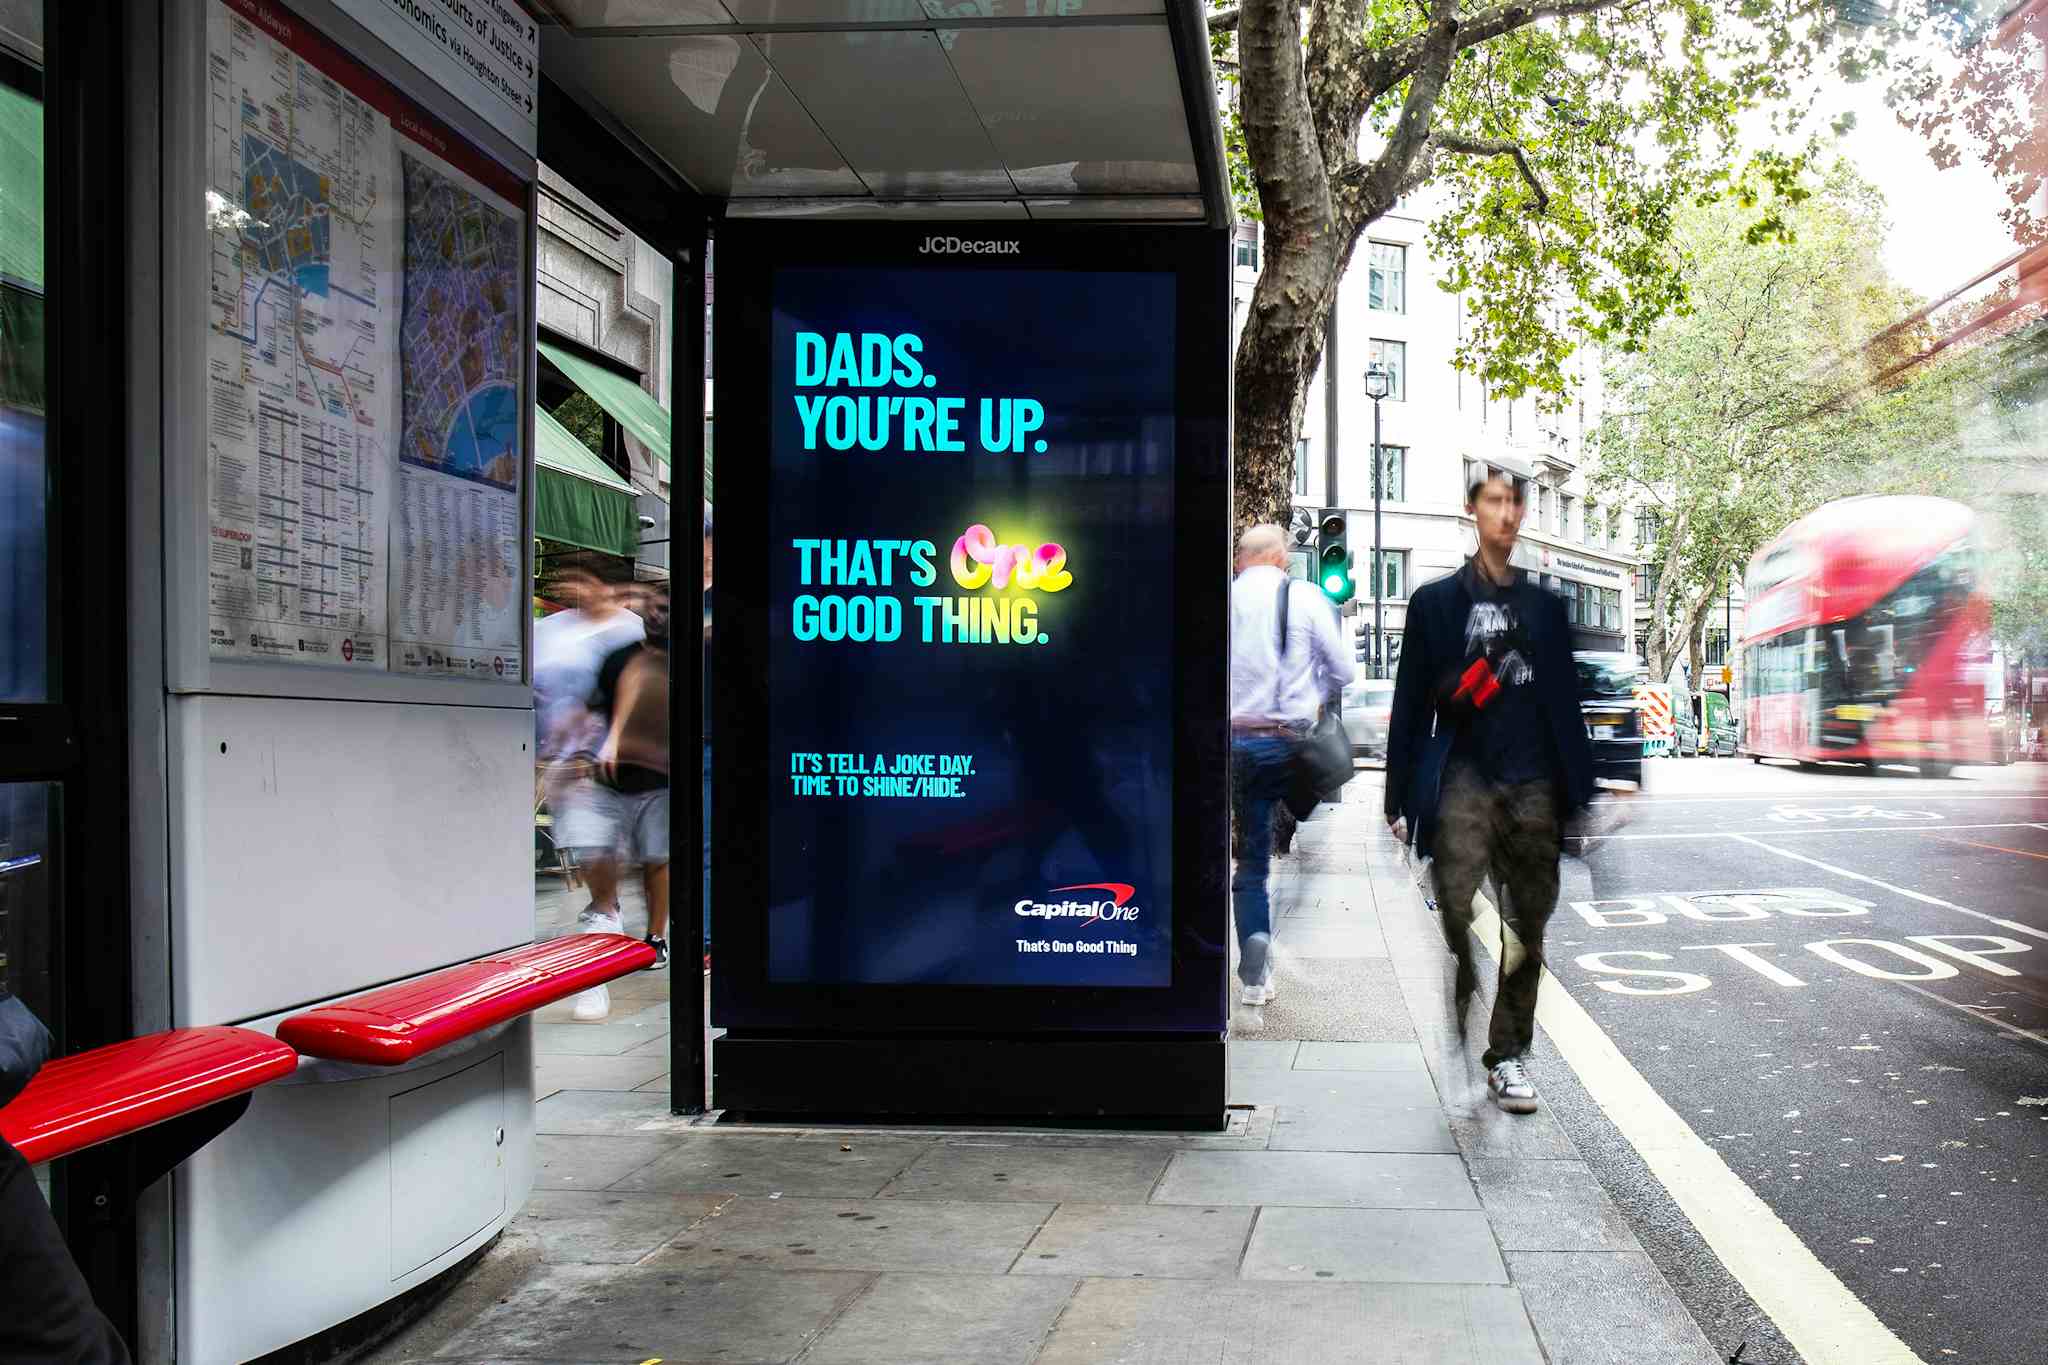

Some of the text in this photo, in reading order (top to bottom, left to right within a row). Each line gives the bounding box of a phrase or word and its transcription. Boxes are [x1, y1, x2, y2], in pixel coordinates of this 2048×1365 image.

[393, 0, 522, 107] onomics via Houghton Street
[441, 0, 523, 71] ourts of Justice
[919, 236, 1021, 254] JCDecaux
[796, 332, 937, 388] DADS.
[794, 395, 1049, 453] YOU'RE UP.
[792, 523, 1074, 593] THAT'S One
[792, 595, 1050, 645] GOOD THING.
[791, 752, 976, 776] IT'S TELL A JOKE DAY.
[791, 775, 967, 798] TIME TO SHINE/HIDE.
[1016, 939, 1138, 957] That's One Good Thing
[1572, 934, 2034, 997] STOP
